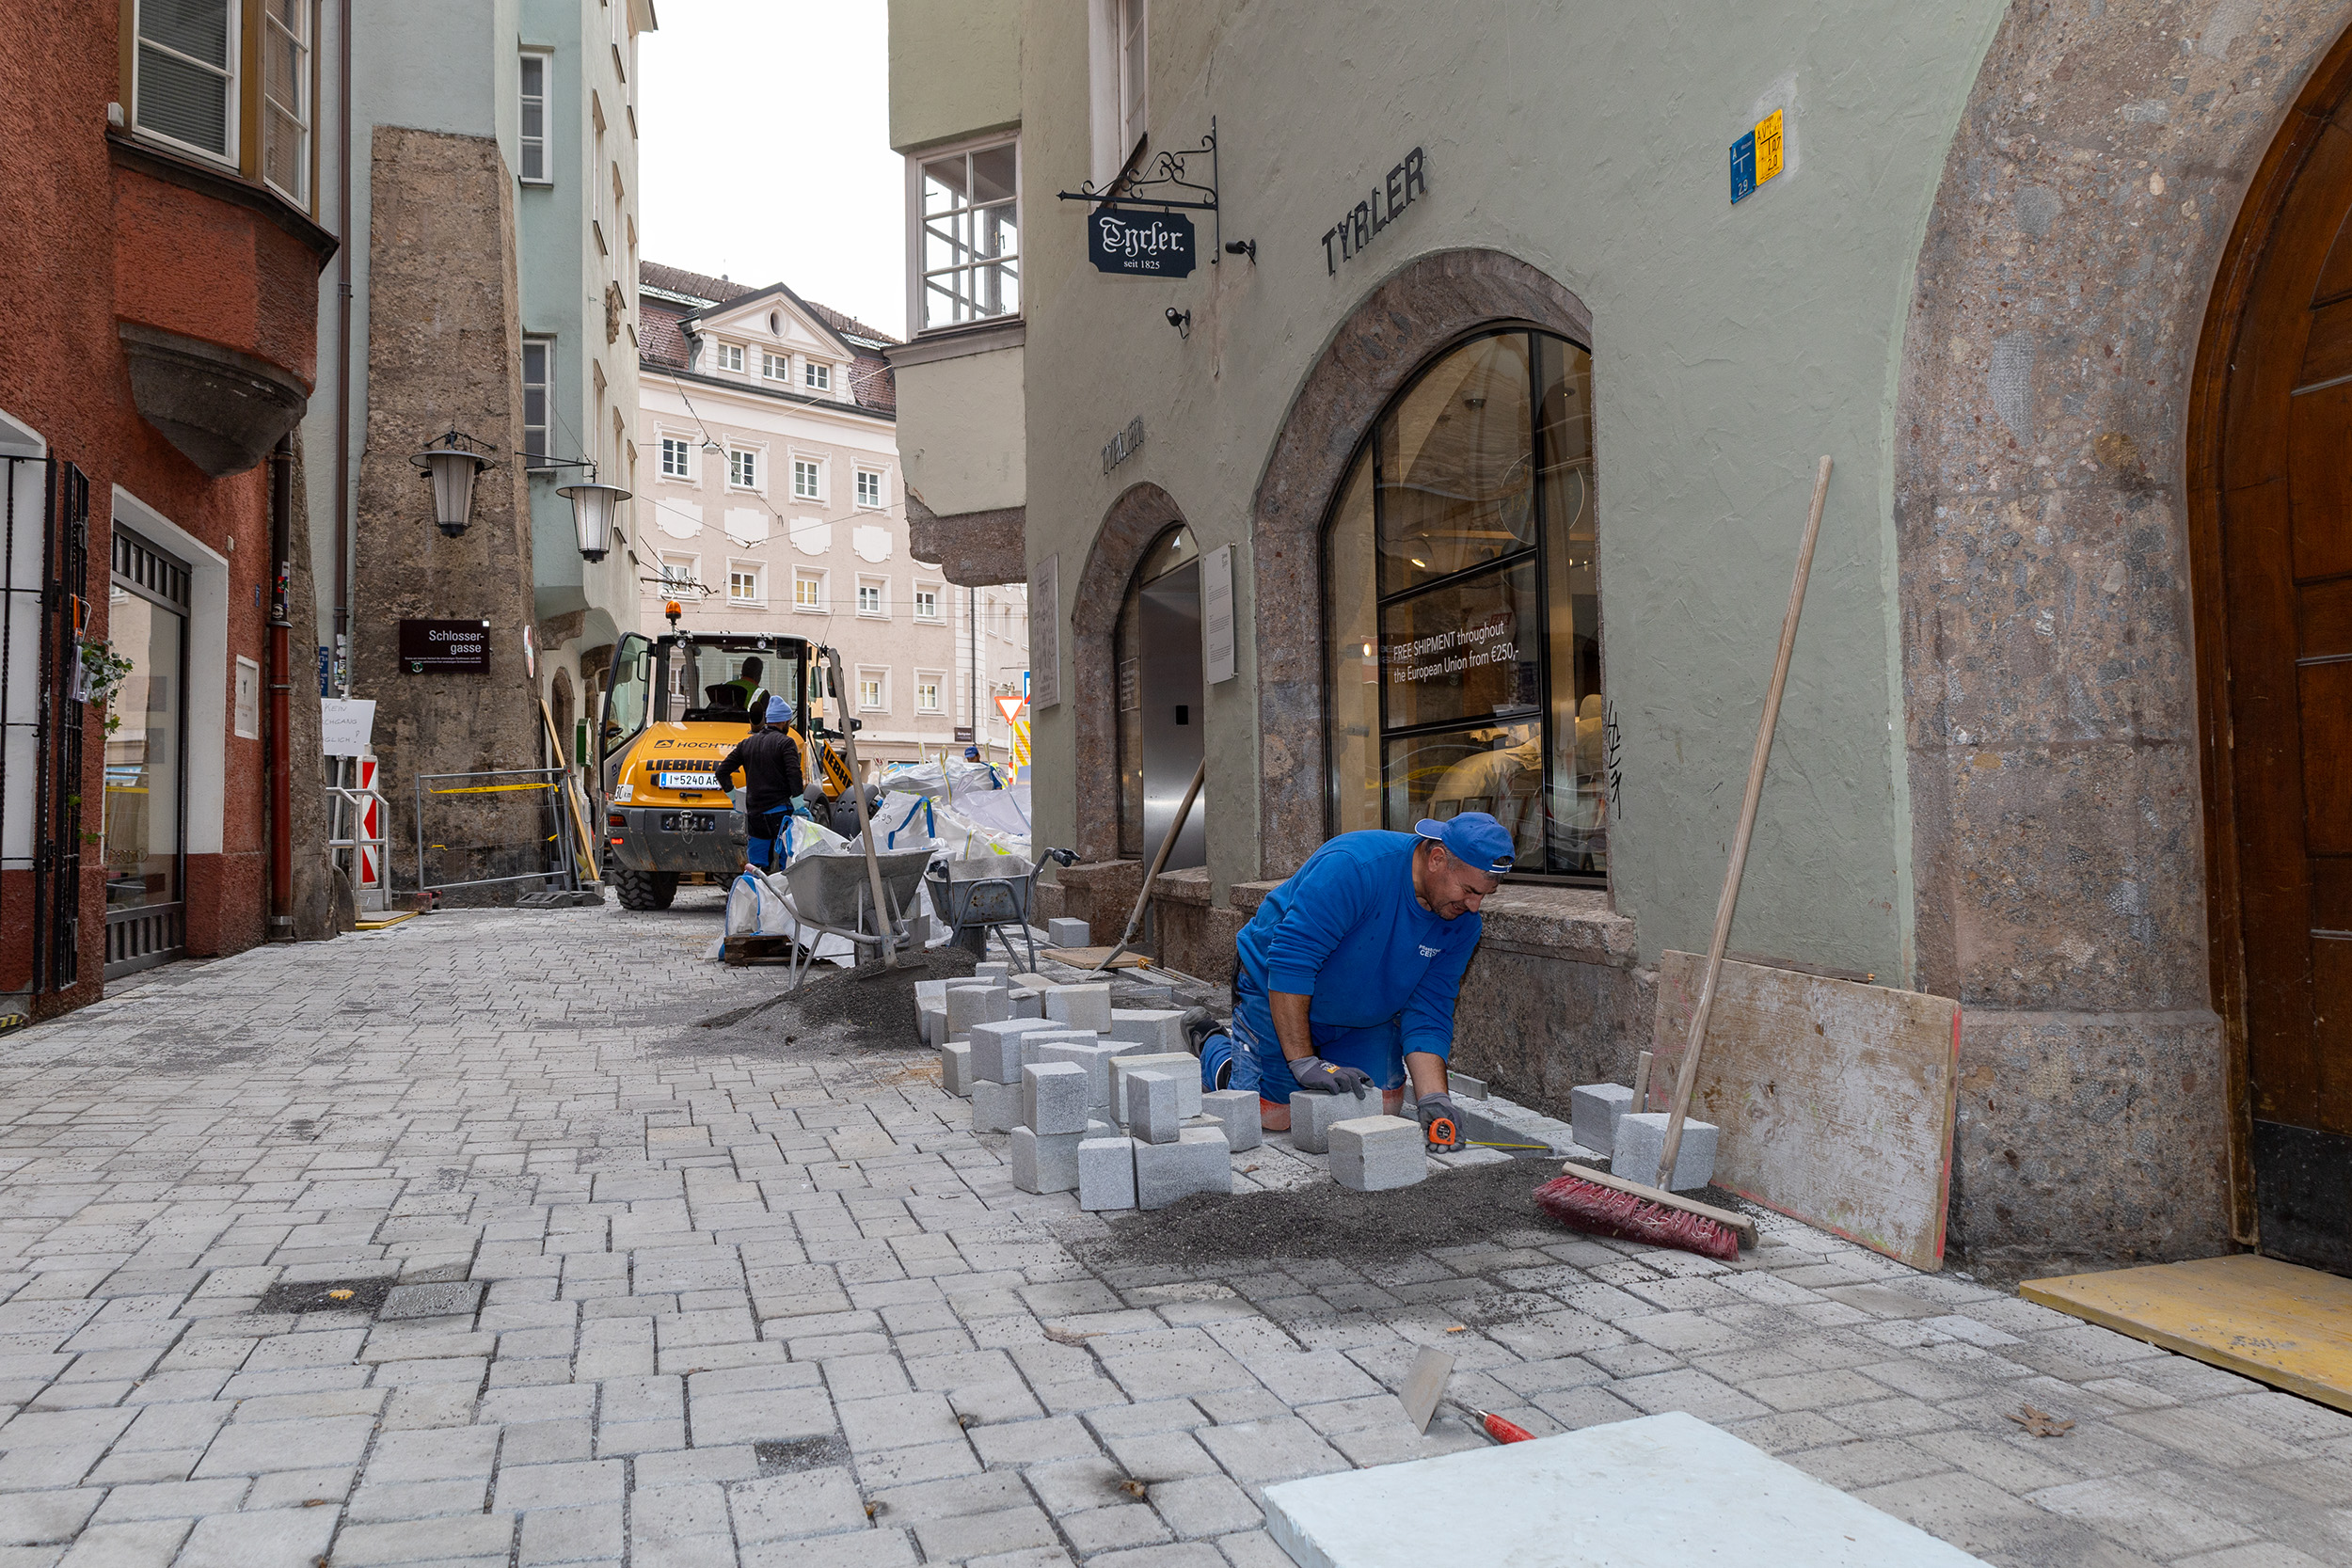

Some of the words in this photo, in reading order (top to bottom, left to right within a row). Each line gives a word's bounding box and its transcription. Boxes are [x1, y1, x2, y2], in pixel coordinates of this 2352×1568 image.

[1322, 146, 1424, 277] TYRLER
[1123, 260, 1138, 268] seit
[1141, 260, 1160, 270] 1825
[428, 629, 485, 641] Schlosser-
[1393, 642, 1412, 661] FREE
[1413, 631, 1455, 657] SHIPMENT
[1457, 620, 1504, 645] throughout
[450, 644, 482, 656] gasse
[1393, 668, 1406, 684] the
[1407, 663, 1442, 683] European
[1444, 656, 1468, 673] Union
[1469, 650, 1489, 669] from
[1490, 641, 1519, 663] €250,-
[325, 703, 347, 712] KEIN
[680, 775, 705, 785] 5240
